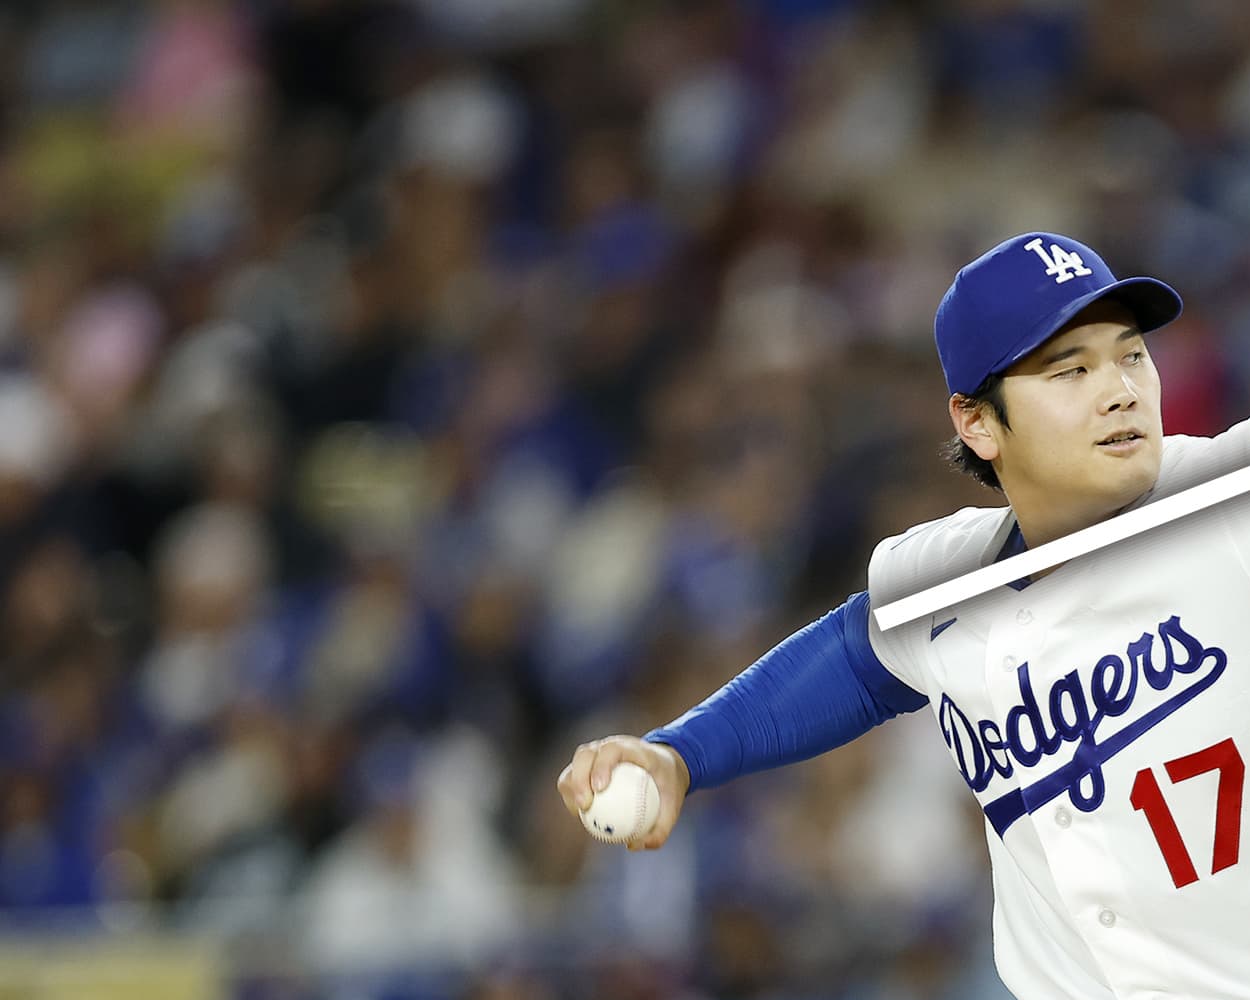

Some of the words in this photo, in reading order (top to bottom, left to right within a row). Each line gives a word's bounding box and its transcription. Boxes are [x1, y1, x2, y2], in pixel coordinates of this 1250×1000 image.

[1023, 237, 1093, 284] LA
[938, 614, 1222, 813] Dodgers
[1129, 737, 1246, 889] 17
